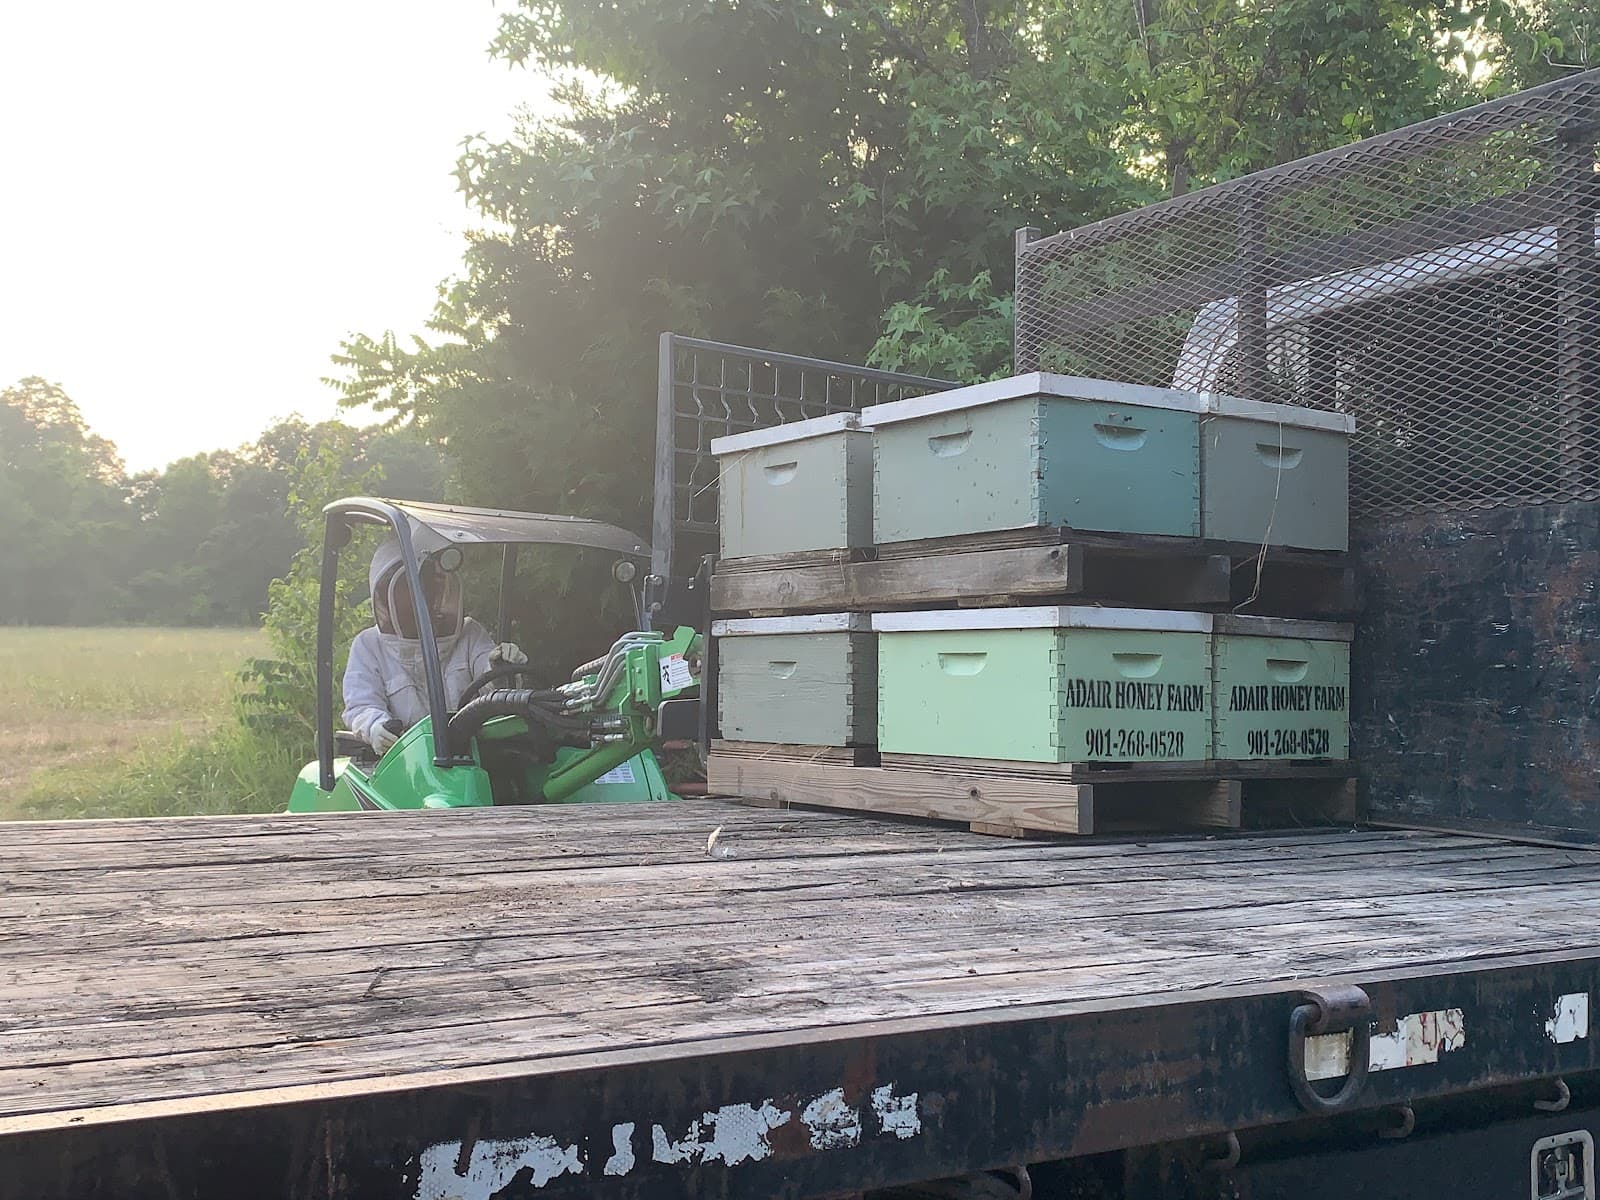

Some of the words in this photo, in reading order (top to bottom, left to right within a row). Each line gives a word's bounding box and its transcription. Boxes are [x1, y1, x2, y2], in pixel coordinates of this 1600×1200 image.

[1065, 679, 1111, 709] ADAIR
[1115, 681, 1164, 711] HONEY
[1167, 684, 1204, 712] FARM
[1229, 685, 1269, 711] ADAIR
[1271, 686, 1314, 711] HONEY
[1315, 686, 1345, 712] FARM
[1085, 728, 1184, 757] 901-268-0528
[1247, 728, 1330, 756] 901-268-0528
